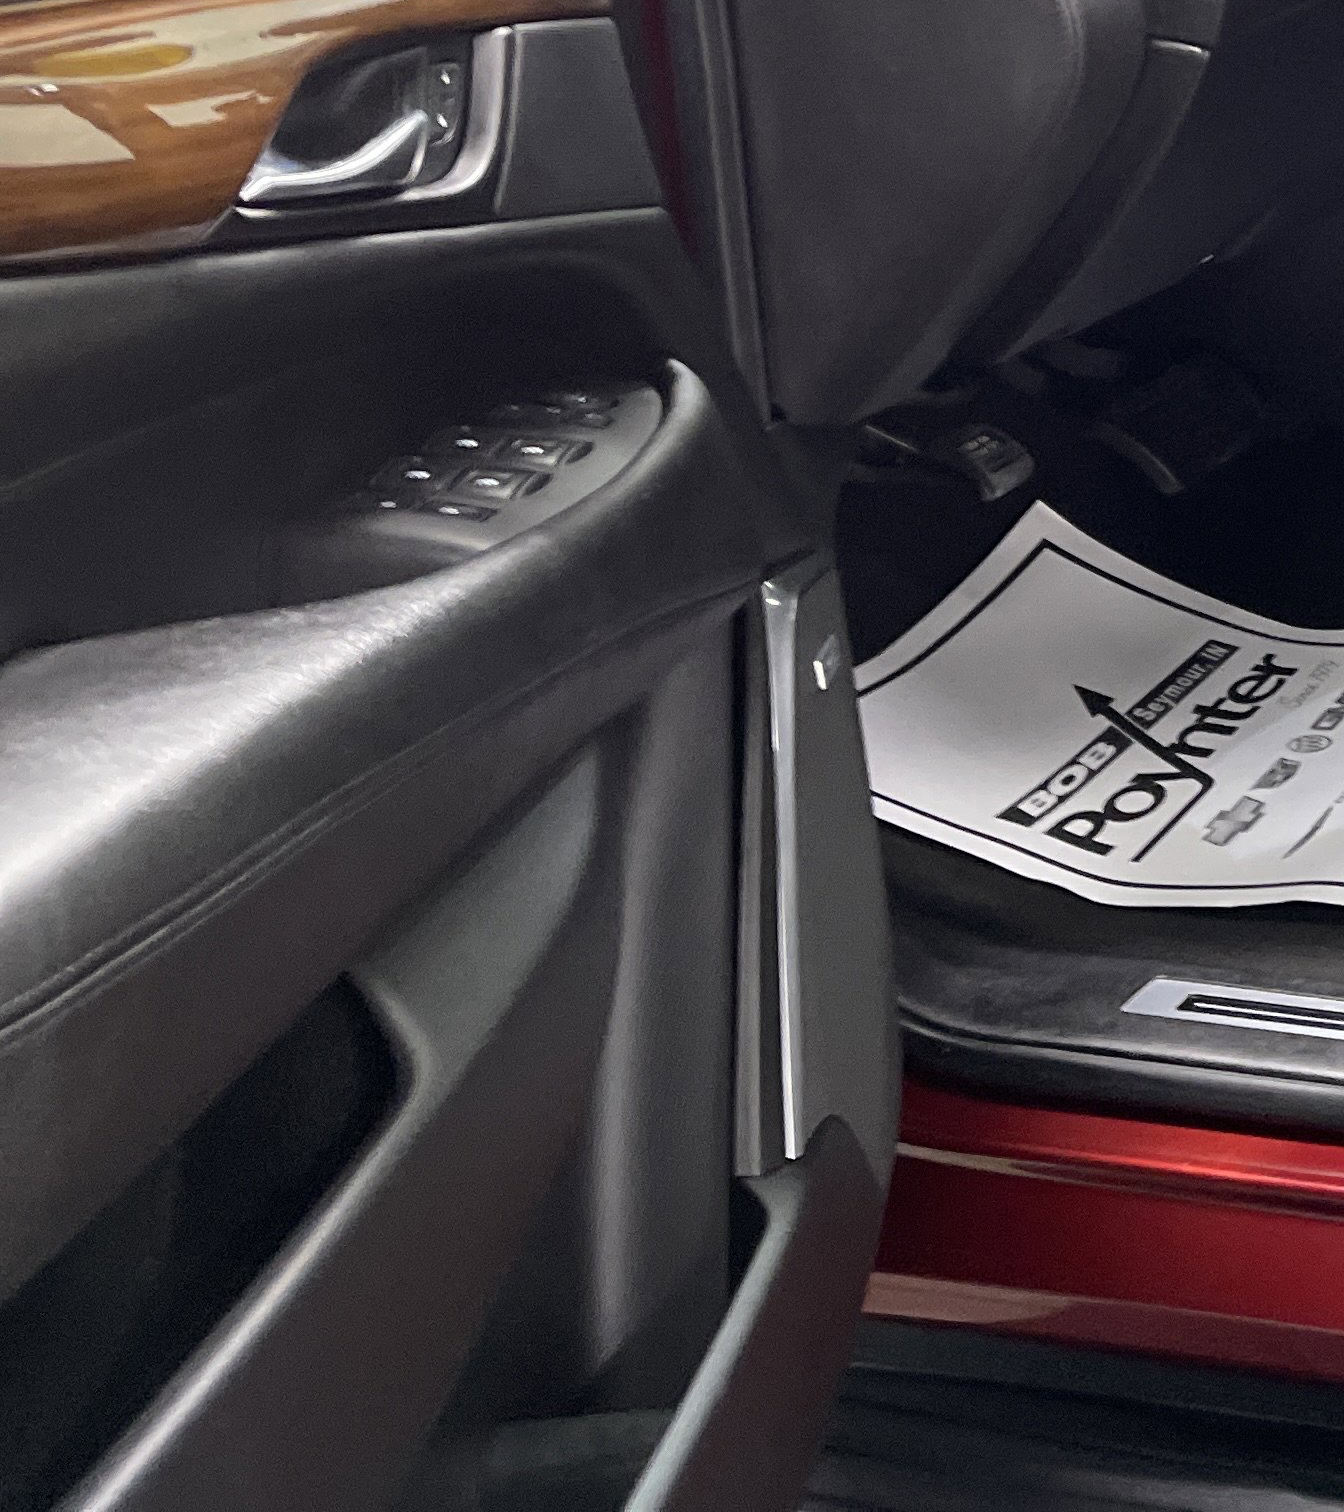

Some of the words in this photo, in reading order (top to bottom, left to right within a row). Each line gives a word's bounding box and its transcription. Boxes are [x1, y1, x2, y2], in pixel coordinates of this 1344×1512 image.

[1205, 643, 1231, 666] IN
[1016, 741, 1118, 817] BOB
[1043, 653, 1298, 862] Poynter
